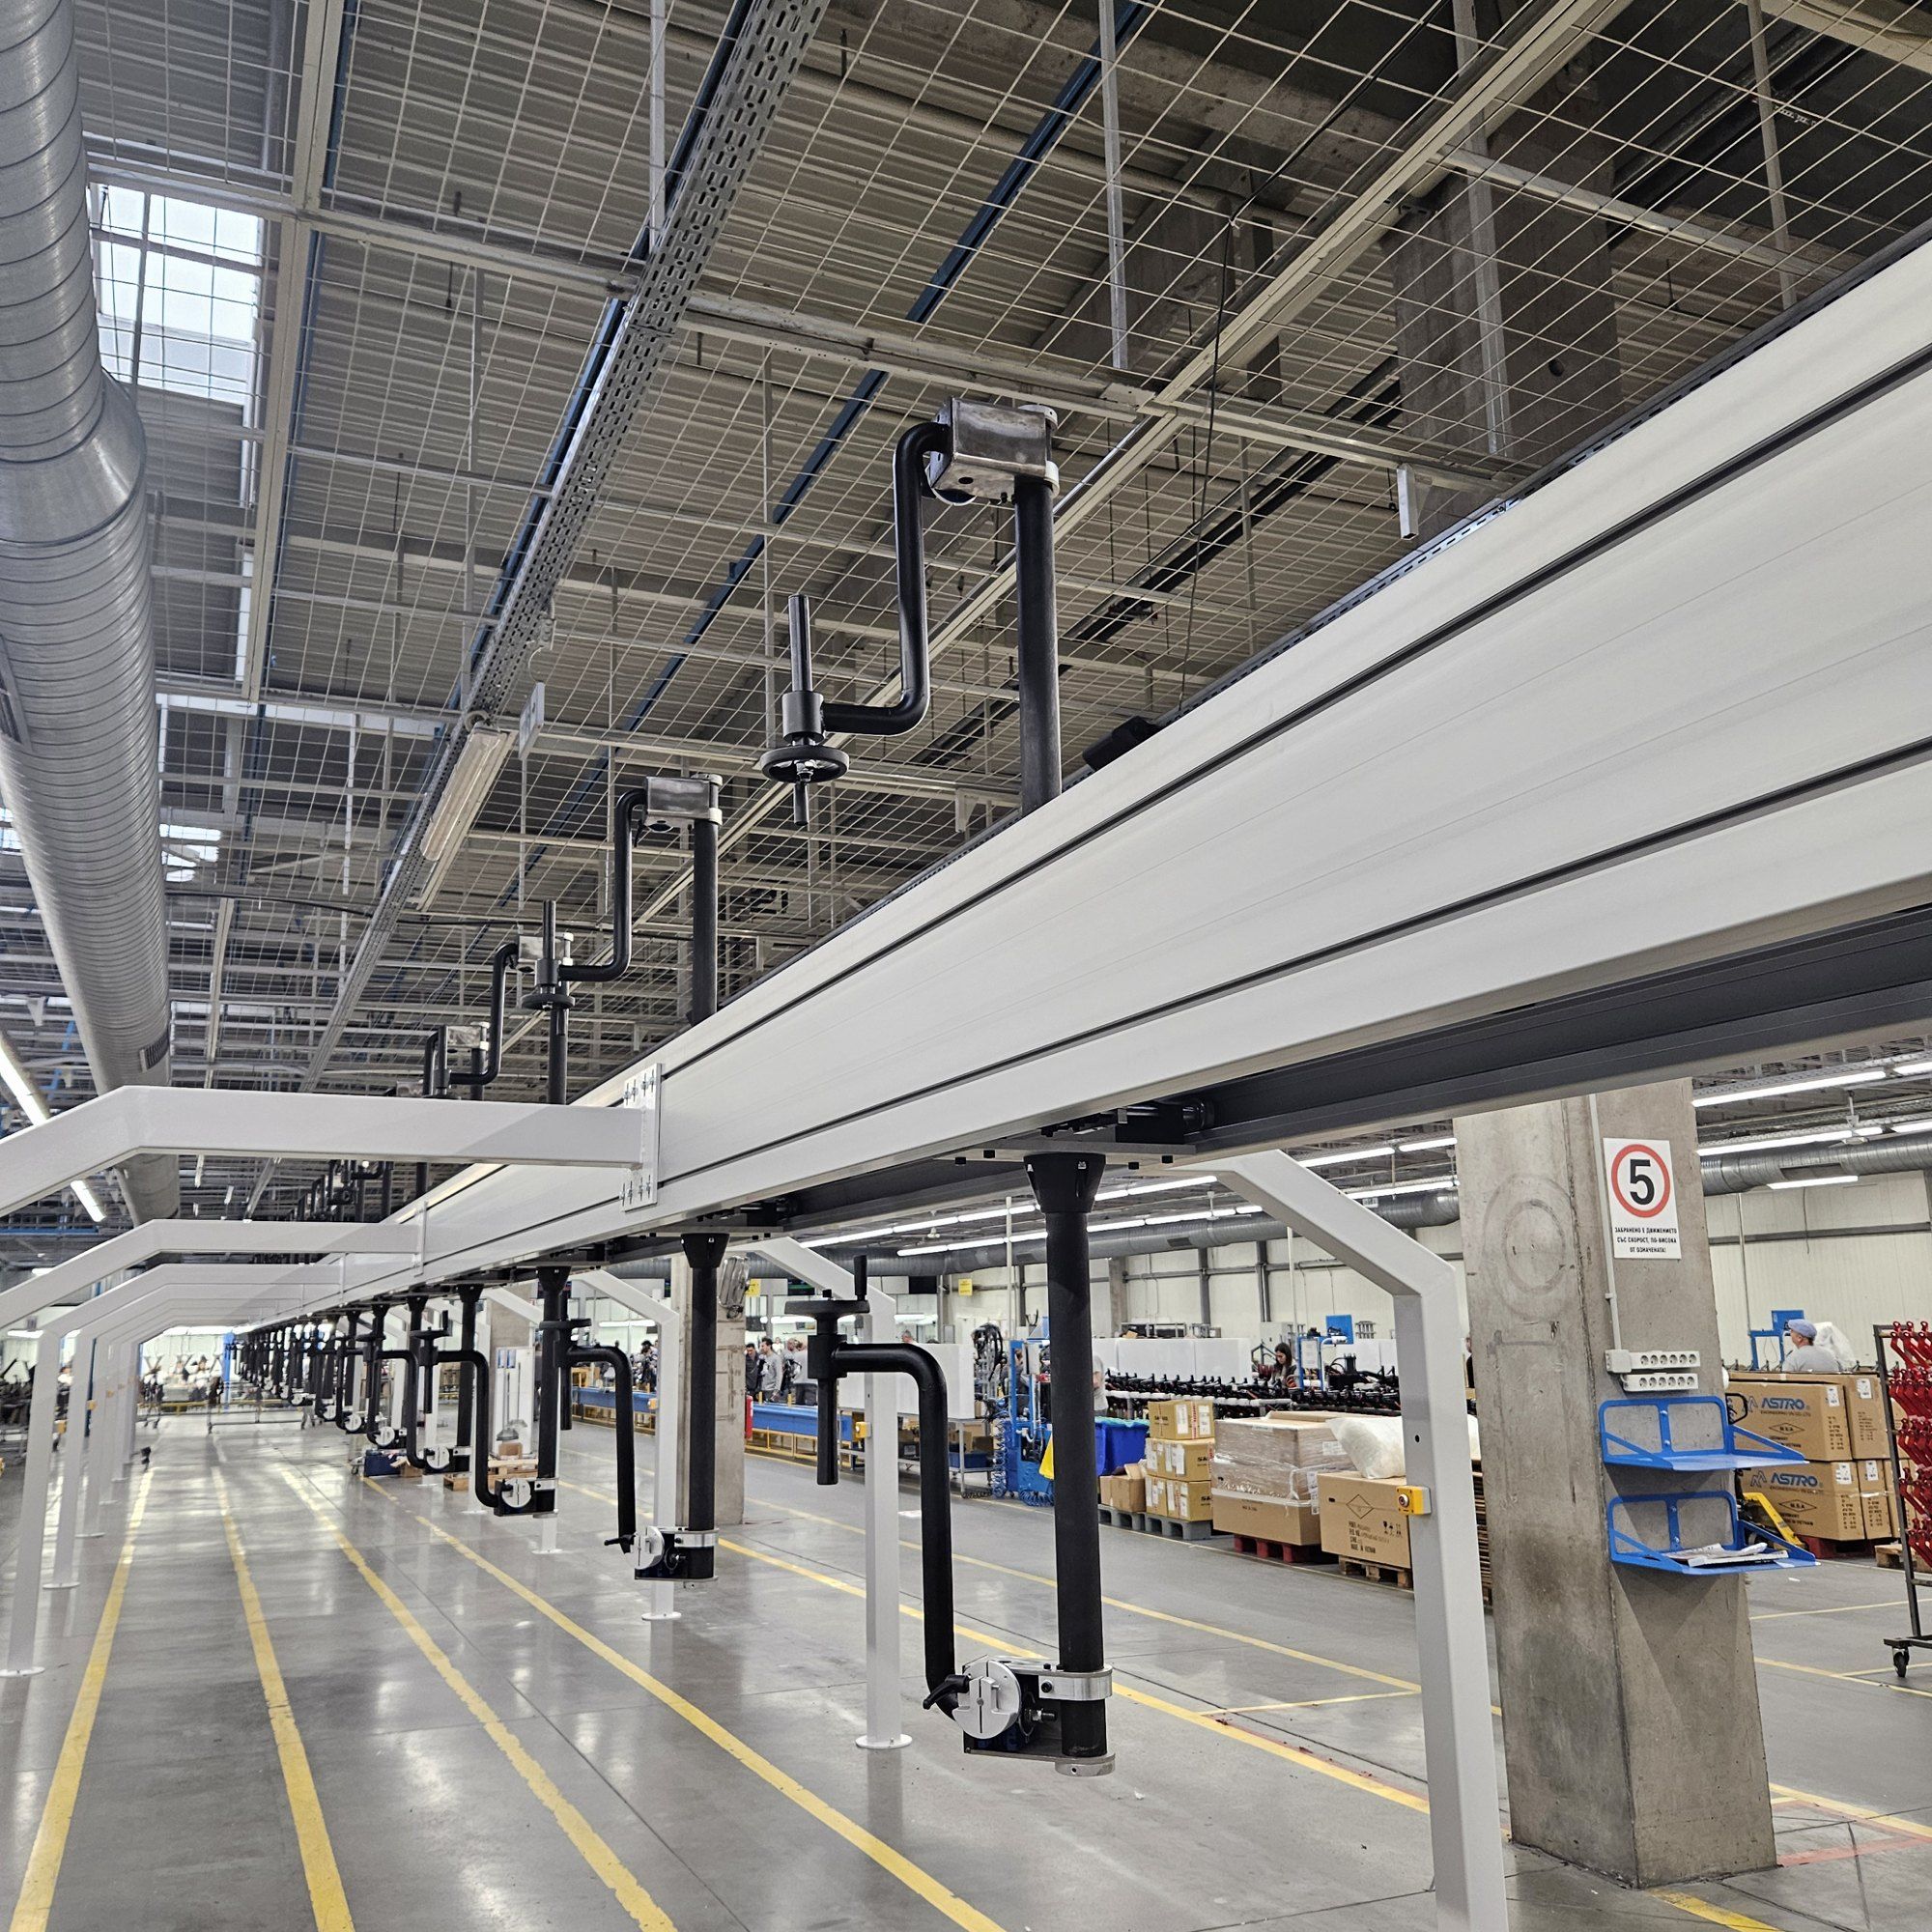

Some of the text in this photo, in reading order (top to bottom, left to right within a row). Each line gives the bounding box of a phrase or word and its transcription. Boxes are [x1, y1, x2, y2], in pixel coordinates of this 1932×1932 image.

[1630, 1158, 1655, 1206] 5
[1761, 1397, 1805, 1410] ASTRO
[1771, 1472, 1818, 1488] ASTRO
